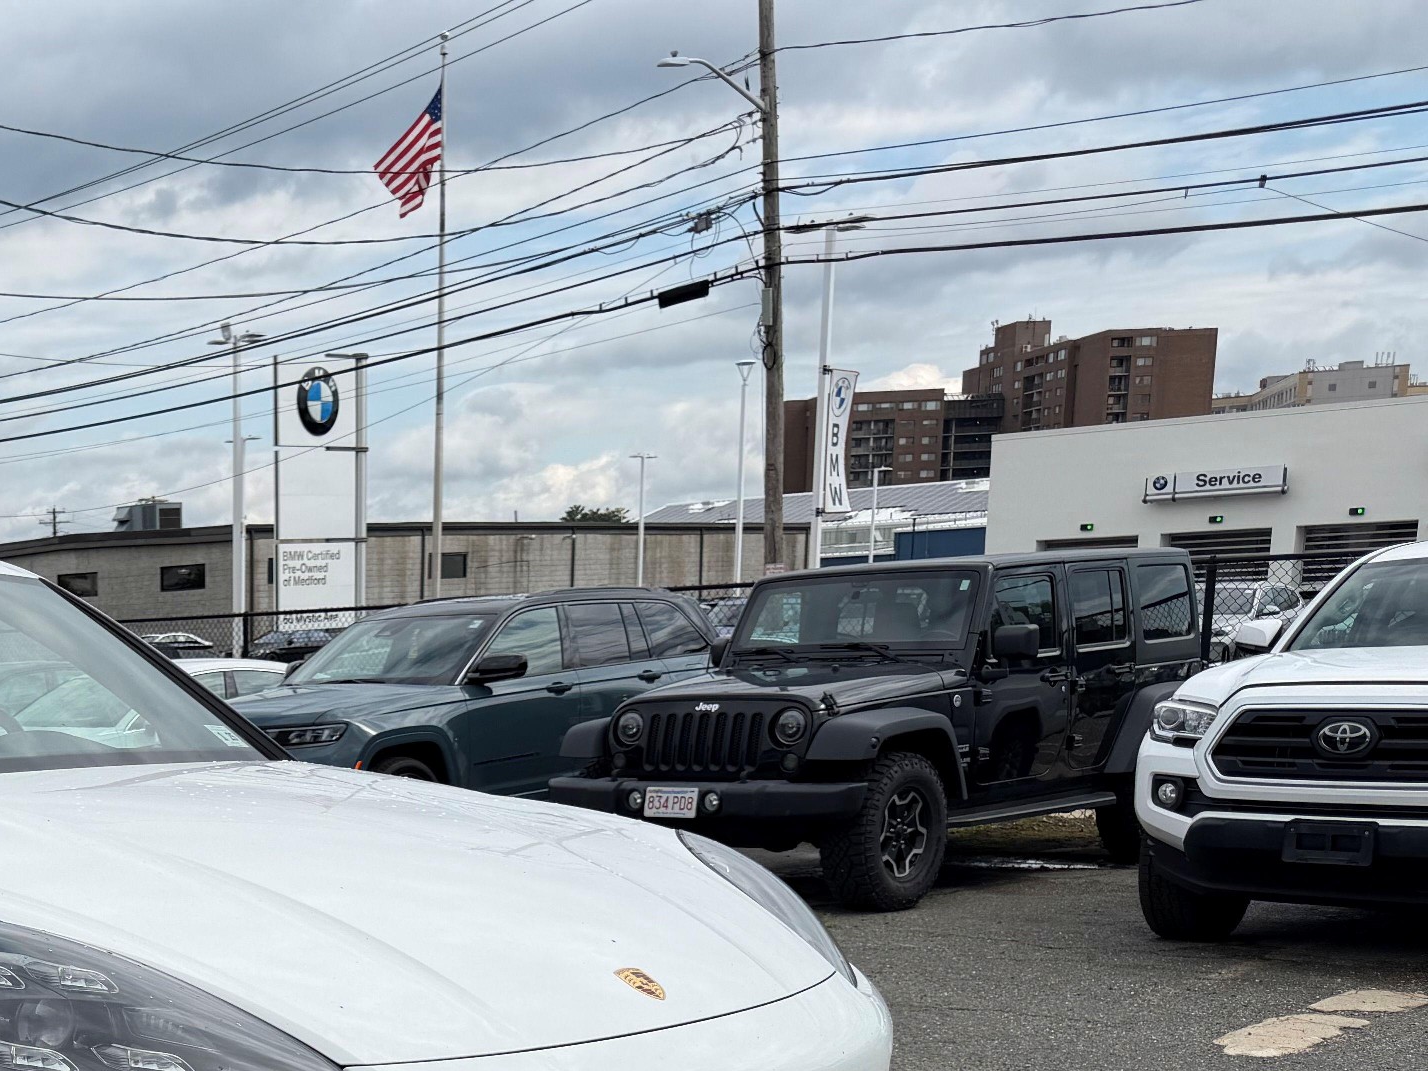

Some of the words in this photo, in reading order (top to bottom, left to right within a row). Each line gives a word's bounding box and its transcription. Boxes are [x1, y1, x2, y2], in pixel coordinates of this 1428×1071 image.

[828, 422, 843, 506] BMW
[1195, 471, 1262, 488] Service
[282, 551, 305, 561] BMW
[306, 550, 340, 560] Certified
[282, 563, 328, 574] Pre-Owned
[282, 576, 292, 587] of
[293, 575, 326, 586] Medford
[695, 702, 720, 712] Jeep
[647, 795, 669, 810] 834
[671, 795, 694, 811] PD8
